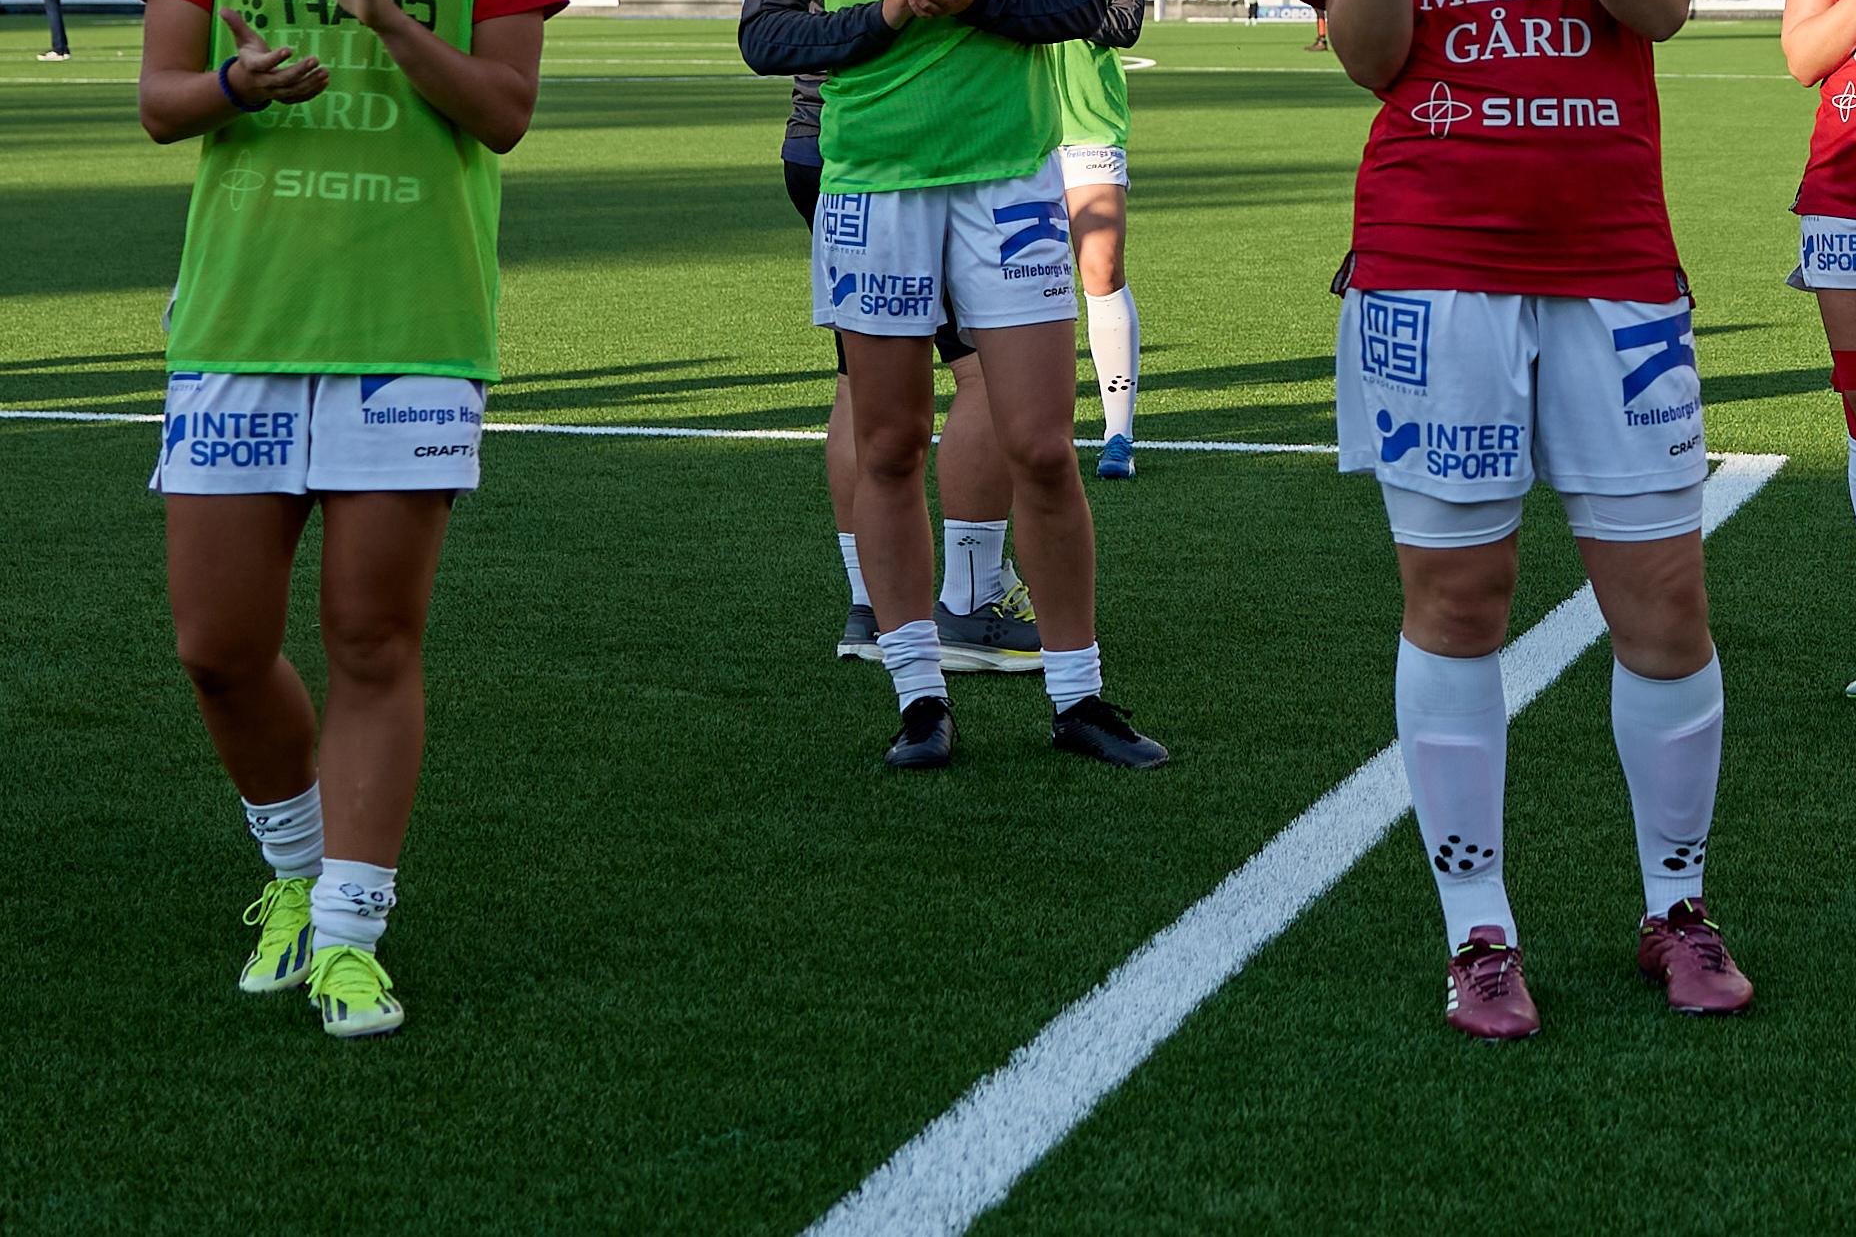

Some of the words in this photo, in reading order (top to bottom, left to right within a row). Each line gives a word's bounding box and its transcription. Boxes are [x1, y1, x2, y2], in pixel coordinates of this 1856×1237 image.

[1445, 6, 1592, 63] GÅRD
[862, 273, 934, 295] INTER
[1002, 264, 1062, 280] Trelleborgs
[860, 294, 934, 316] SPORT
[192, 413, 294, 439] INTER
[362, 406, 455, 425] Trelleborgs
[1624, 401, 1693, 426] Trelleborgs
[1427, 423, 1519, 450] INTER
[190, 440, 294, 467] SPORT
[414, 445, 469, 458] CRAFT
[1426, 450, 1518, 479] SPORT
